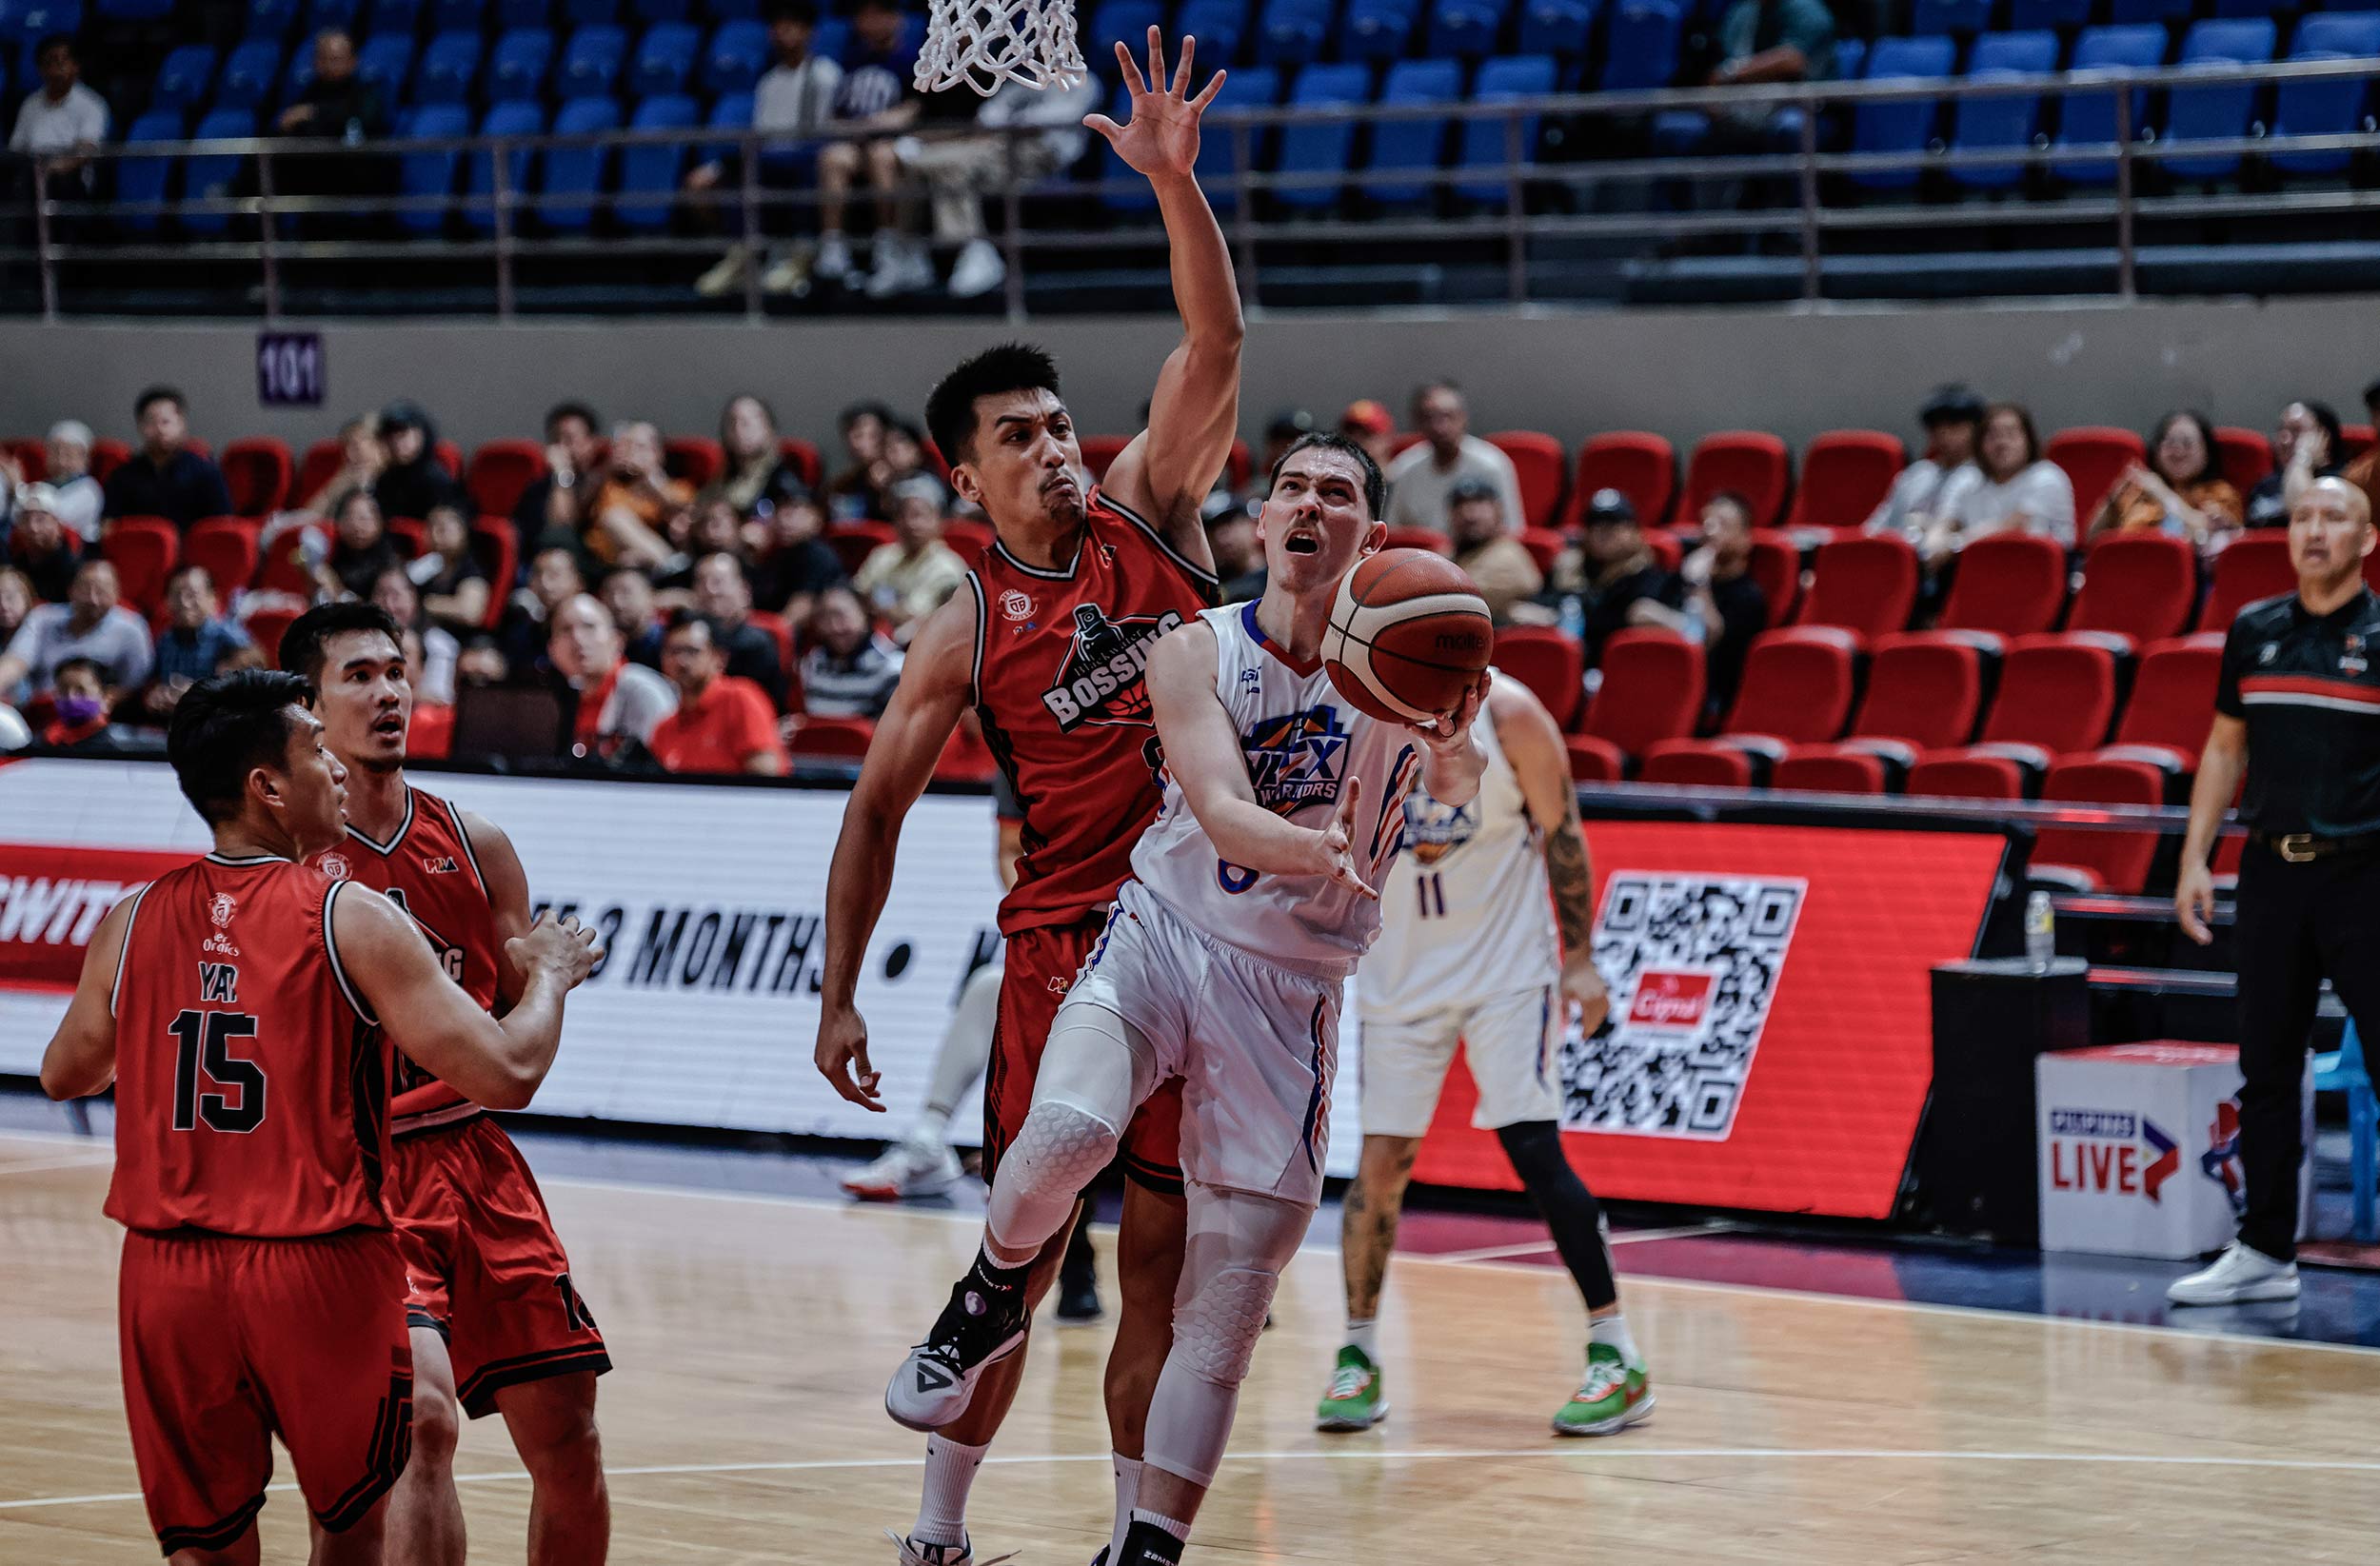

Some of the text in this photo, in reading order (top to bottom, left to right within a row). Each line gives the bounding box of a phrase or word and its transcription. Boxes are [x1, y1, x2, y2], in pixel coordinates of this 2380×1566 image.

[263, 343, 317, 395] 101
[0, 874, 149, 946] WIT
[1417, 872, 1445, 917] 11
[168, 1009, 268, 1134] 15
[2052, 1141, 2136, 1195] LIVE
